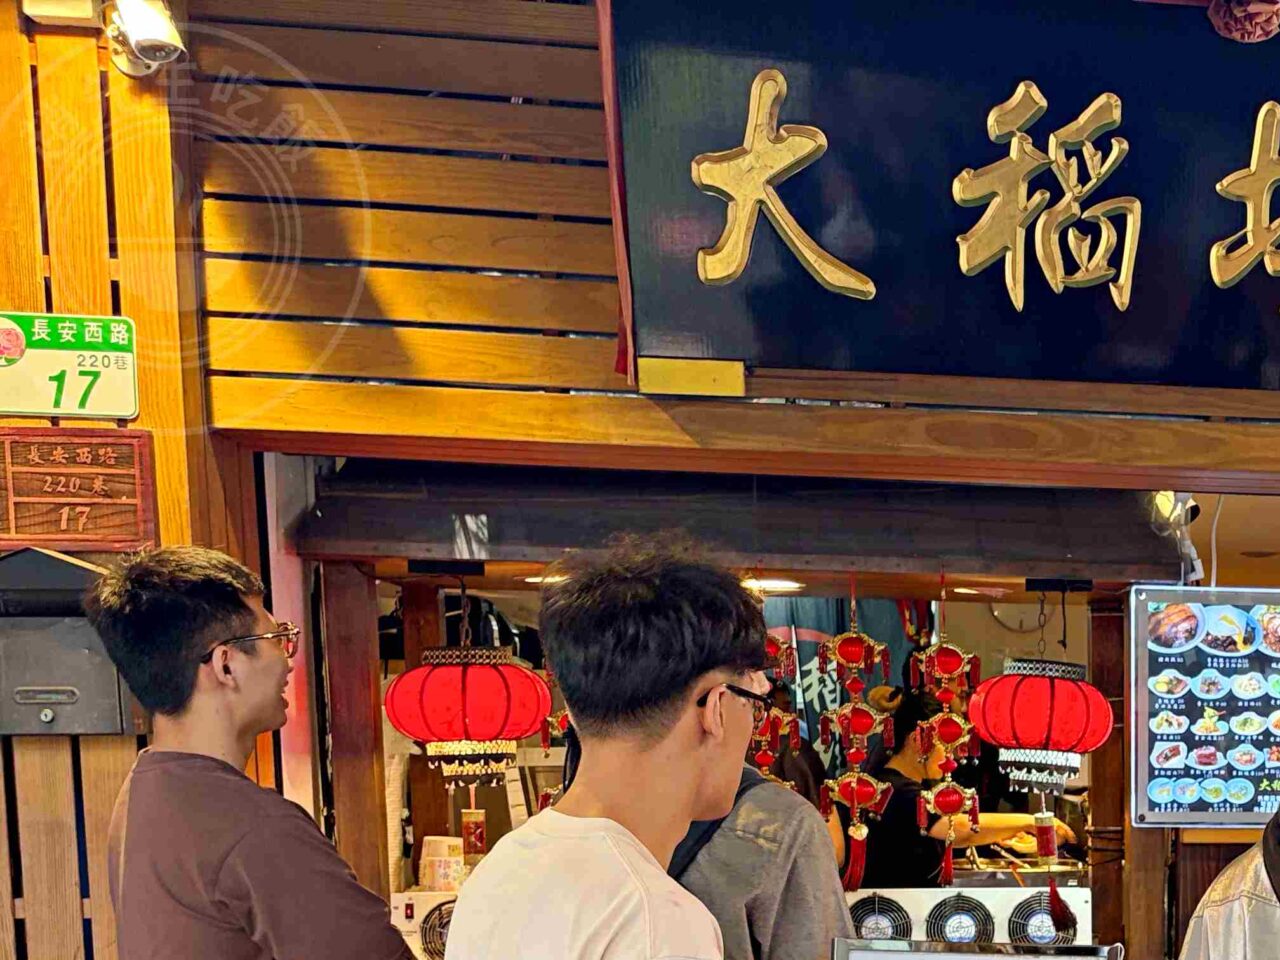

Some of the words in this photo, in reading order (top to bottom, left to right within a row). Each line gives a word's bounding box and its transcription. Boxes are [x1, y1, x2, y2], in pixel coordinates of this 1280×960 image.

[31, 319, 129, 345] 長安西路
[77, 354, 129, 370] 220巷
[48, 369, 101, 409] 17
[27, 445, 118, 465] 長安西路
[58, 506, 91, 532] 17
